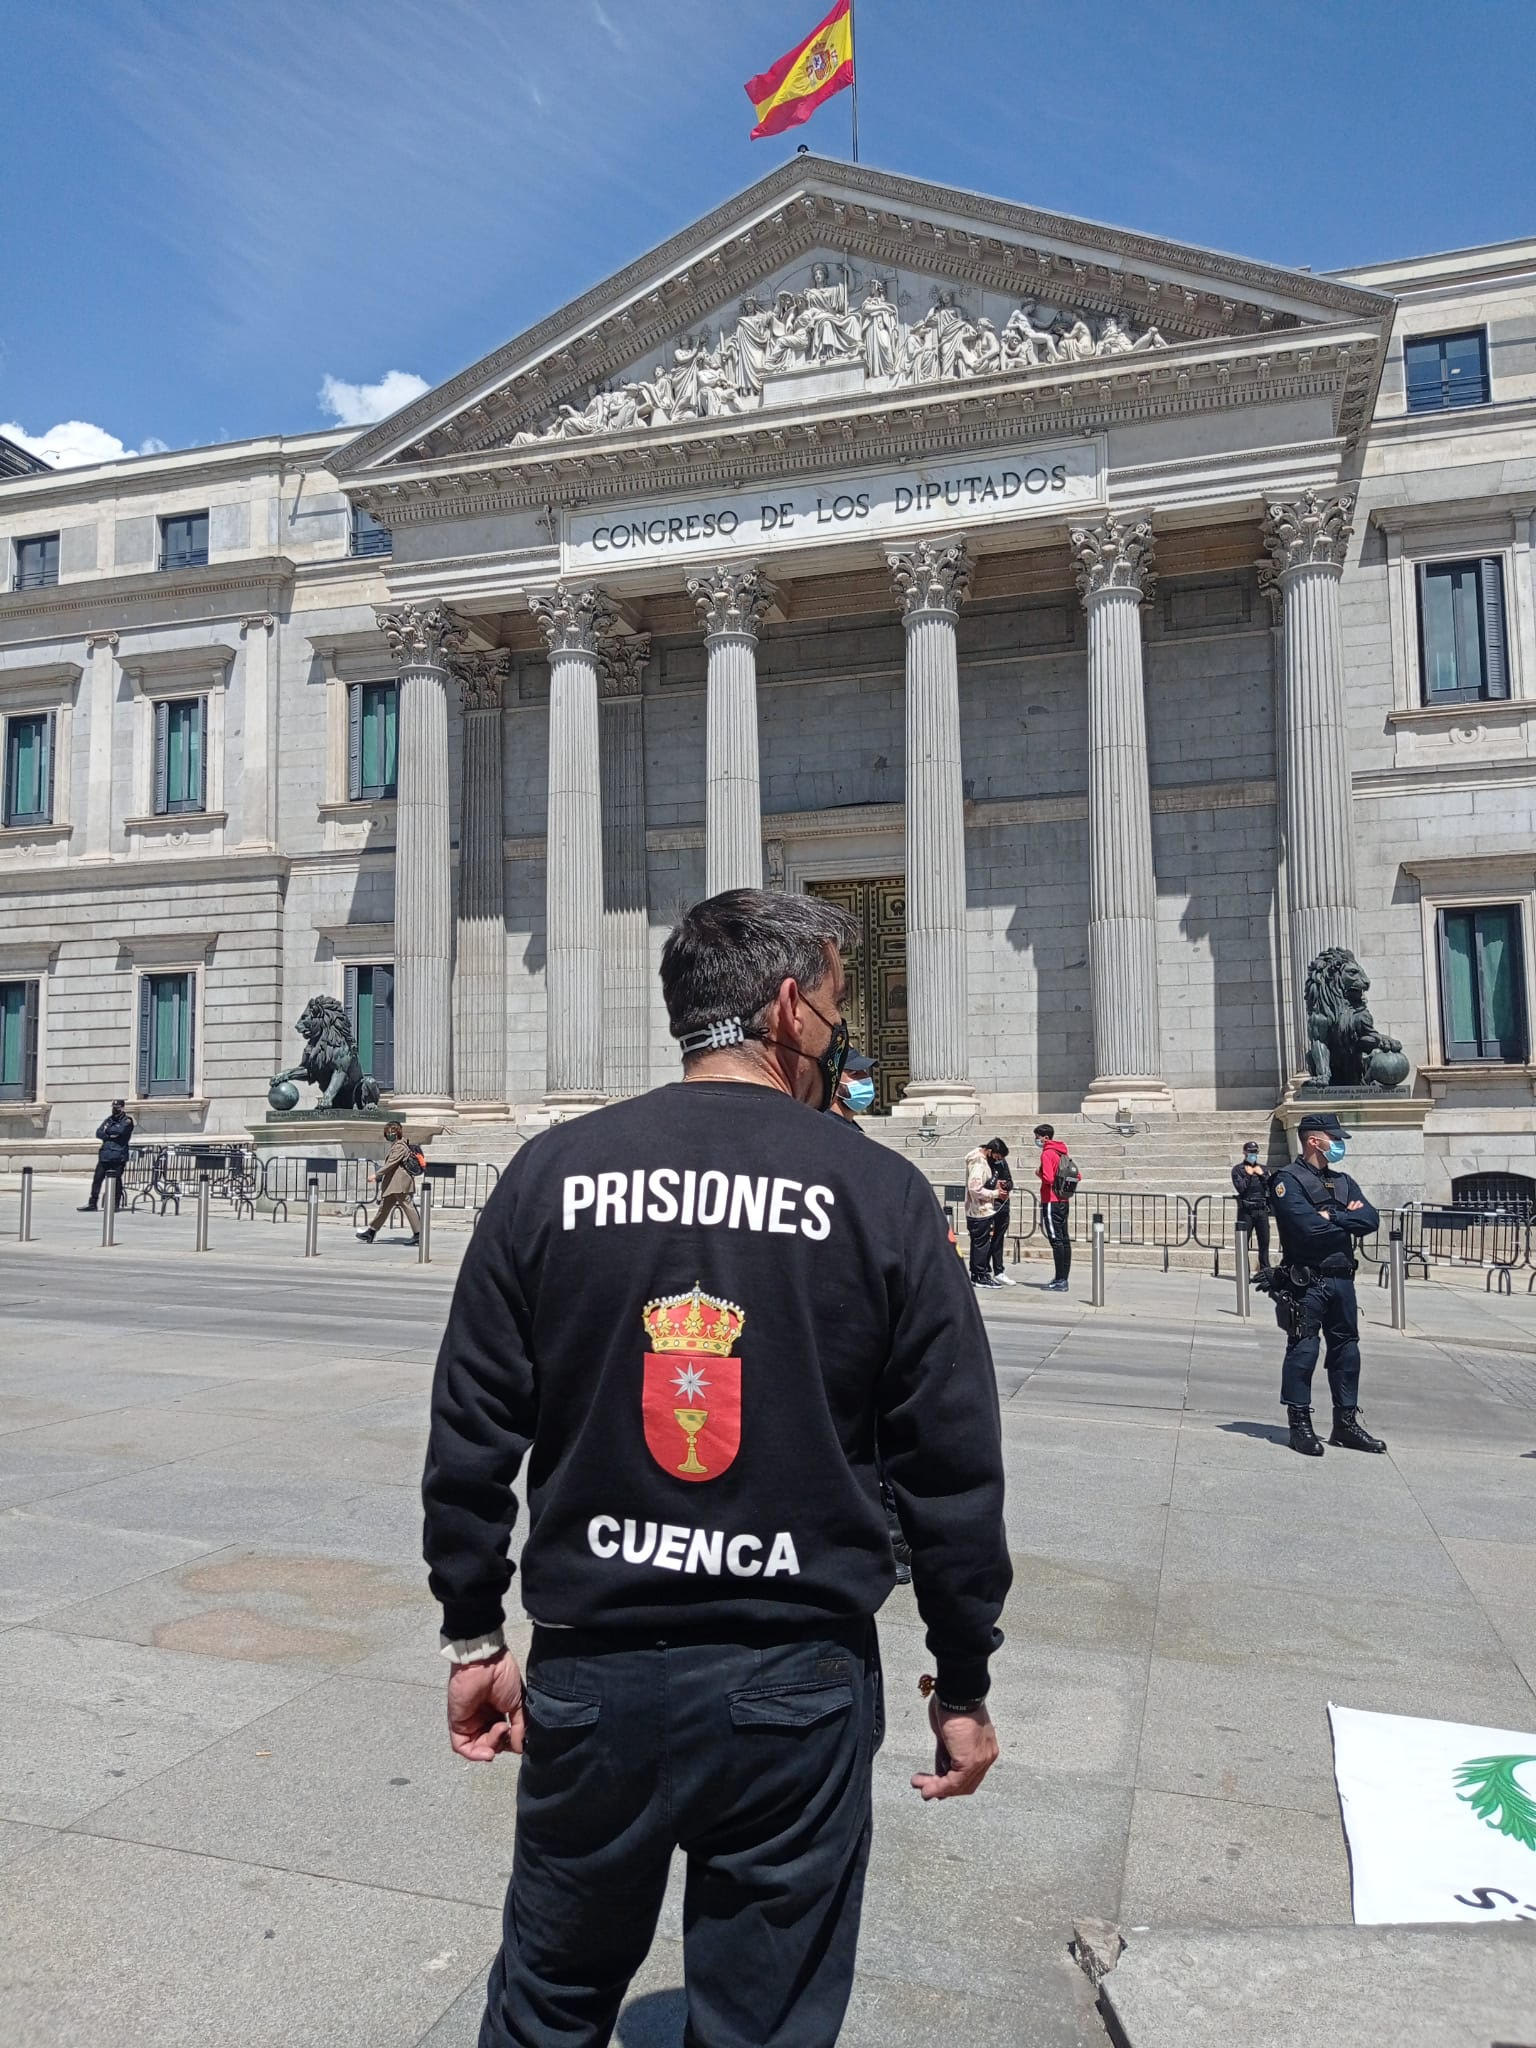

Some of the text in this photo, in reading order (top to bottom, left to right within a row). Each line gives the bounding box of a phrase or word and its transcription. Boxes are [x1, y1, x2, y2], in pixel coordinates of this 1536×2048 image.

[592, 465, 1067, 551] CONGRESO DE LOS DIPUTADOS
[562, 1168, 835, 1241] PRISIONES
[587, 1515, 801, 1577] CUENCA
